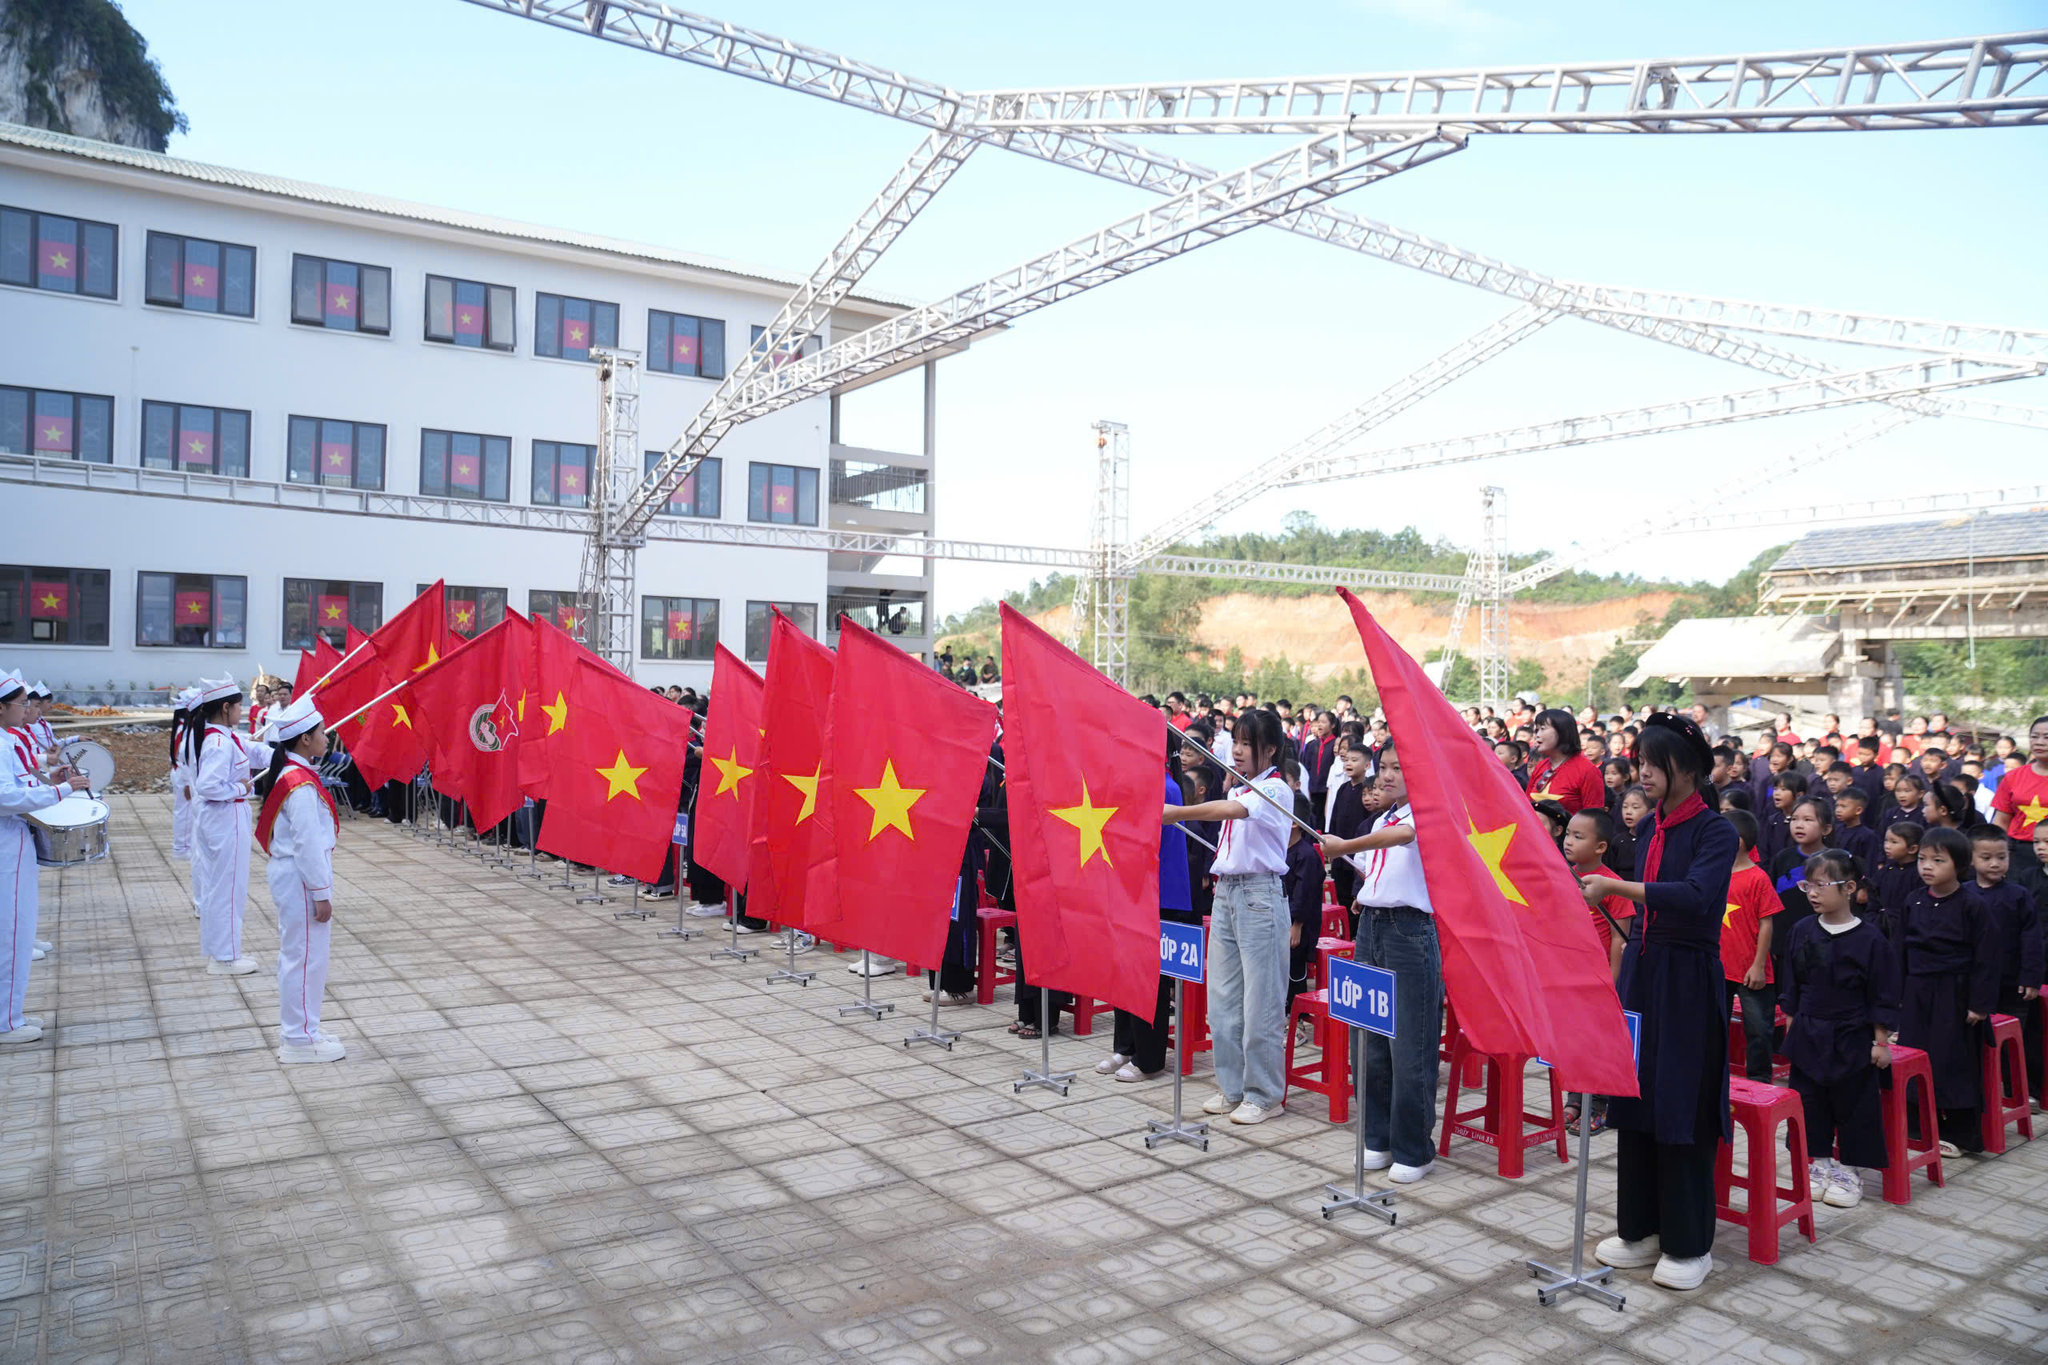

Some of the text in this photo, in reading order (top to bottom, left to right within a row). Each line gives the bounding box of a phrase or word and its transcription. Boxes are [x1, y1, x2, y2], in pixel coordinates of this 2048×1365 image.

[1160, 933, 1199, 967] ỚP 2A
[1333, 975, 1389, 1018] LỚP 1B
